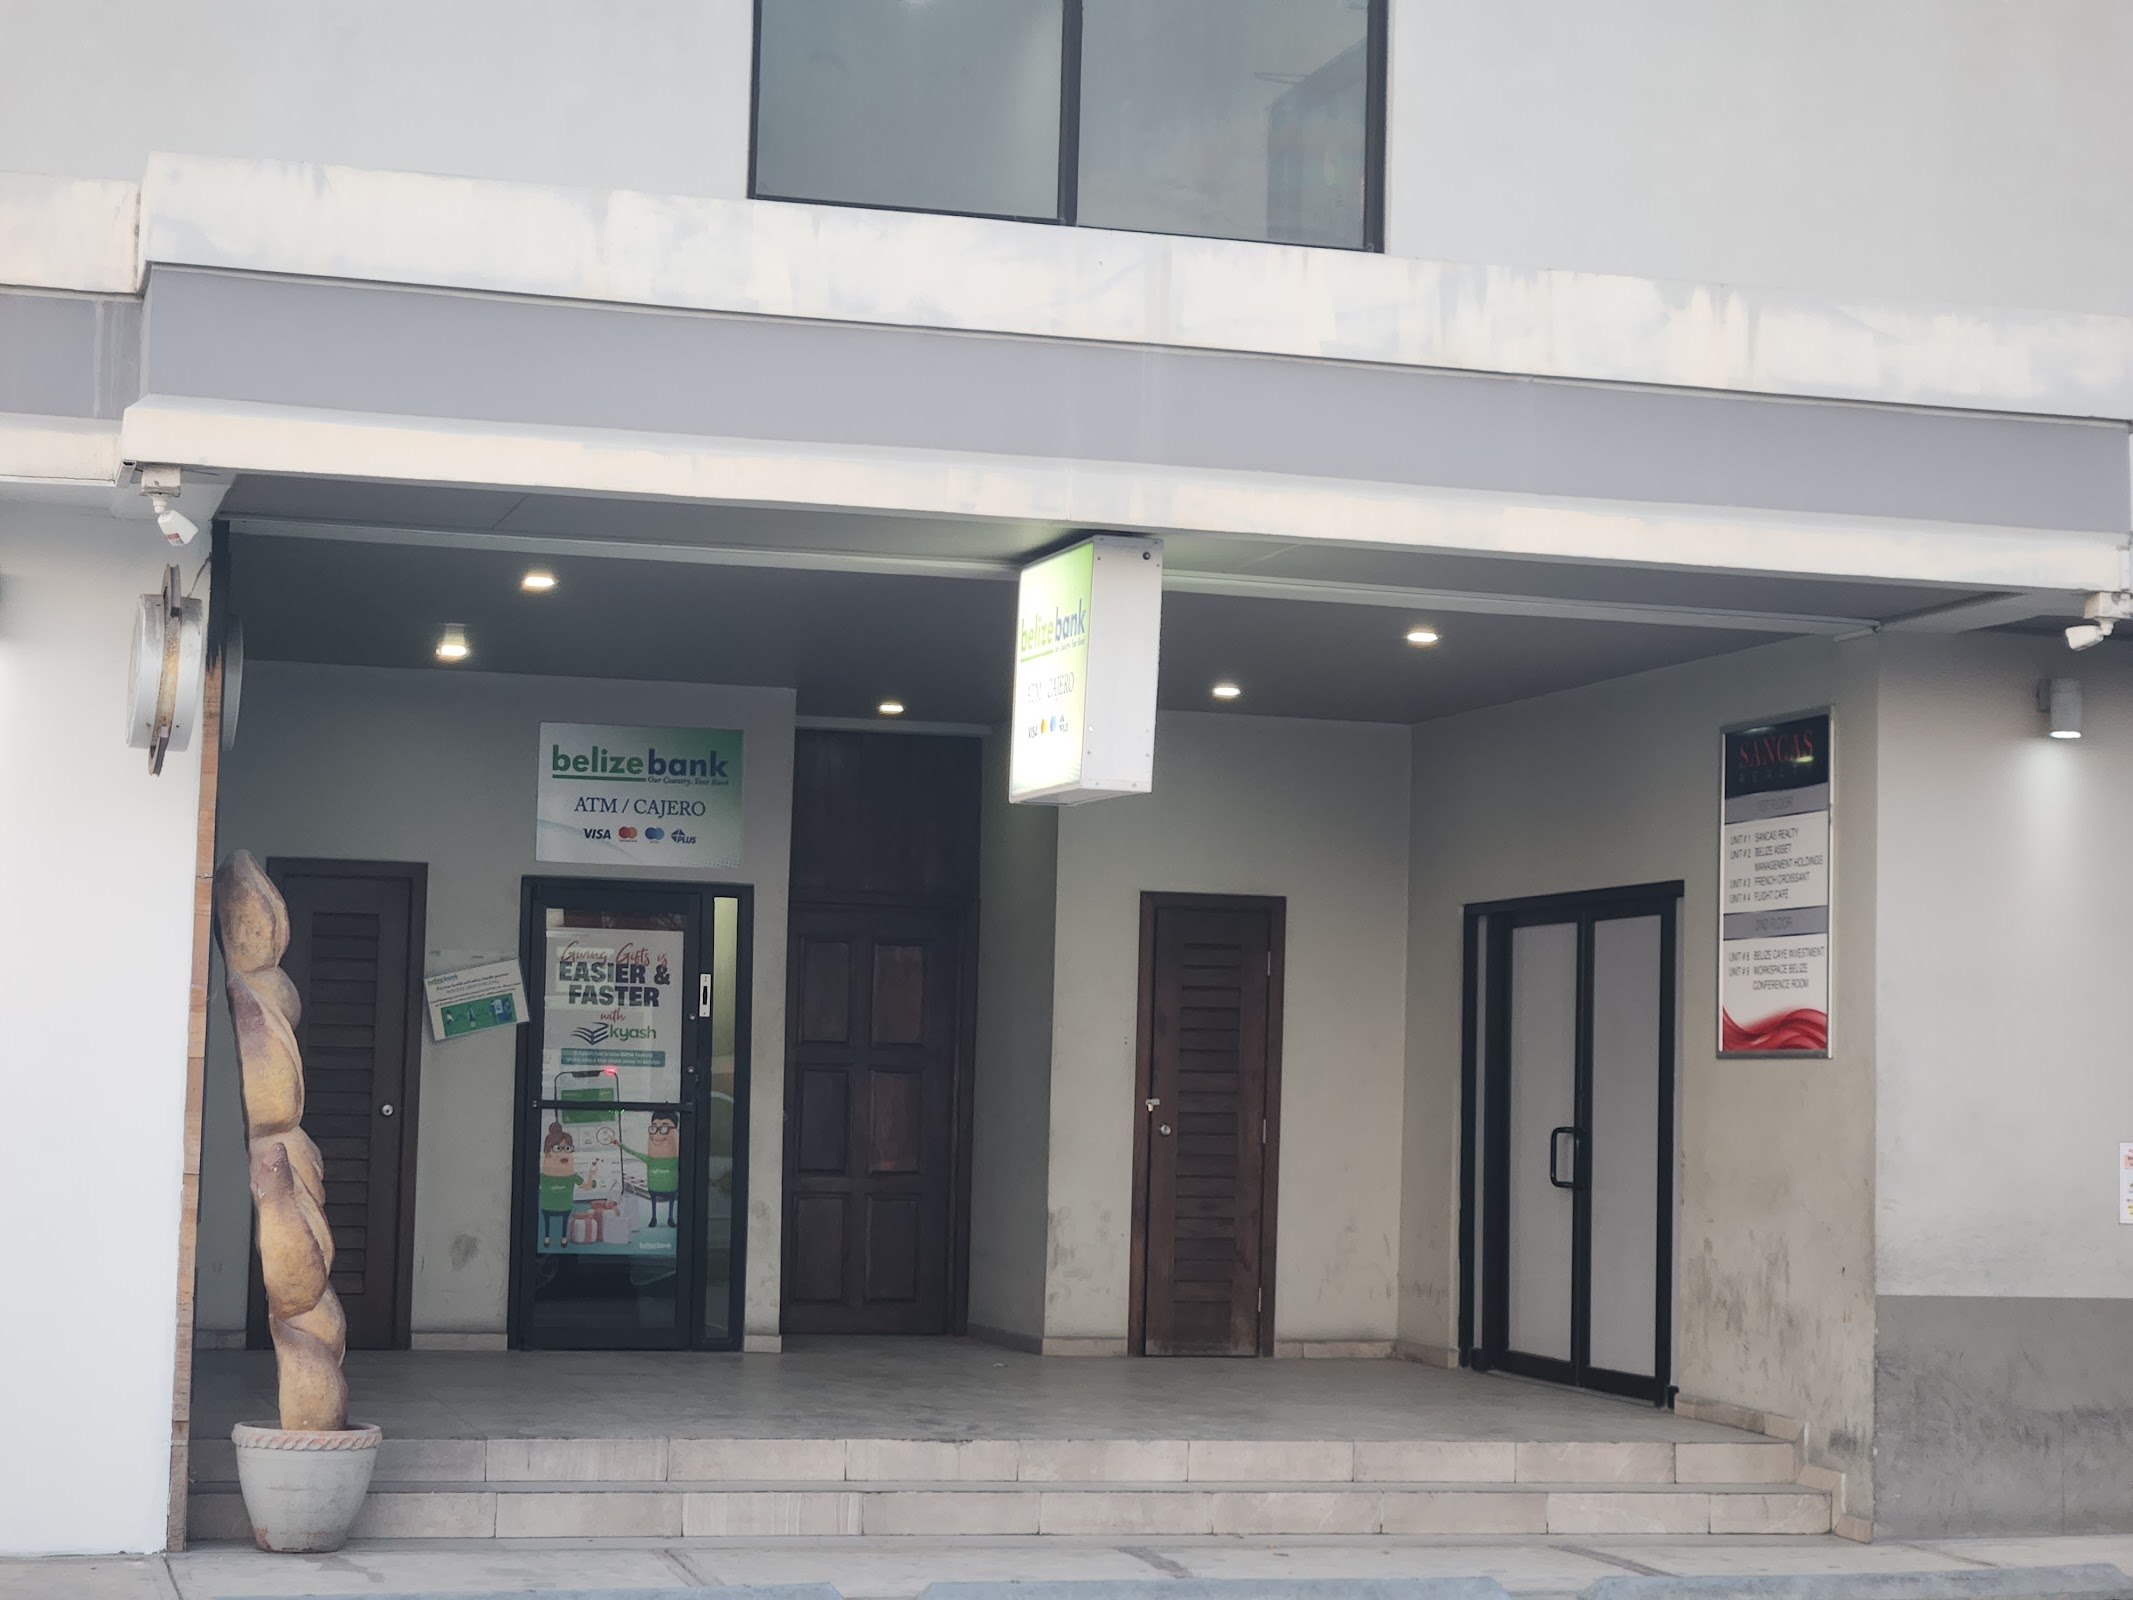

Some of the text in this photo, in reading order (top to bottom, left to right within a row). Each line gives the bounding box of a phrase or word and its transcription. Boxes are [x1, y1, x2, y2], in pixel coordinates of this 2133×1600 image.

[574, 797, 706, 819] ATM / CAJERO
[582, 828, 697, 845] VISA PLUS
[615, 942, 651, 967] Gifts
[656, 952, 668, 968] is
[559, 960, 671, 986] EASIER &
[568, 984, 660, 1008] FASTER
[600, 1008, 627, 1022] with
[609, 1024, 657, 1042] kyash
